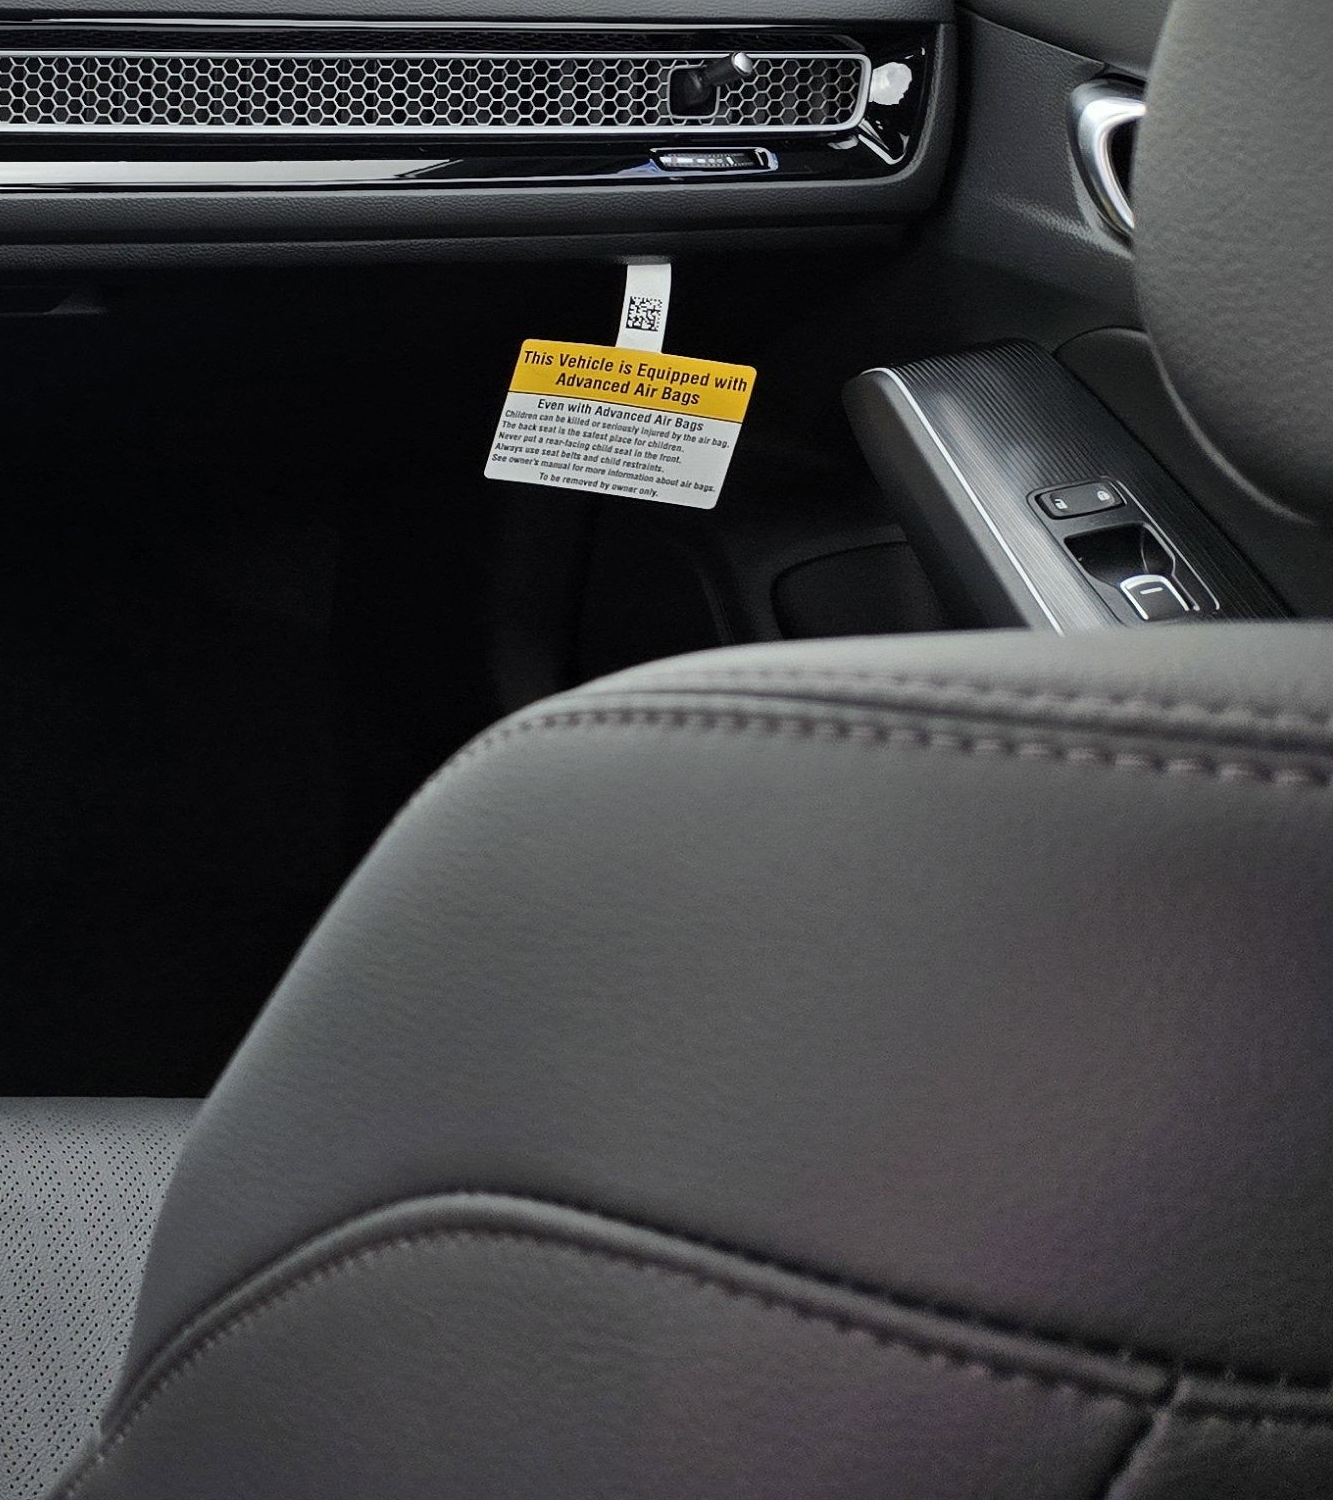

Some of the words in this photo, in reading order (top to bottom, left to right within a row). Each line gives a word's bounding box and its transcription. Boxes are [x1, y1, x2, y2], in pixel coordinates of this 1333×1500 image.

[524, 350, 554, 365] This
[559, 354, 614, 372] Vehicle
[619, 360, 633, 375] is
[637, 363, 710, 386] Equipped
[714, 376, 748, 392] with
[555, 372, 631, 394] Advanced
[633, 382, 658, 398] Air
[661, 386, 700, 406] Bags
[505, 409, 538, 420] Children
[567, 415, 590, 427] killed
[601, 422, 640, 435] seriously
[640, 426, 670, 438] injured
[683, 433, 697, 443] the
[698, 435, 711, 445] air
[712, 437, 730, 449] bag.
[537, 399, 564, 411] Even
[567, 402, 592, 414] with
[594, 405, 652, 423] Advanced
[653, 415, 672, 426] Air
[674, 417, 704, 432] Bags
[498, 431, 522, 441] Never
[545, 437, 590, 451] rear-facing
[591, 443, 613, 453] child
[614, 447, 633, 456] seat
[643, 450, 658, 460] the
[659, 452, 682, 464] front.
[501, 420, 516, 430] The
[518, 422, 537, 431] back
[538, 425, 557, 434] seat
[567, 427, 581, 437] the
[582, 429, 609, 440] safest
[609, 434, 632, 445] place
[633, 437, 647, 447] for
[647, 440, 685, 452] children.
[491, 453, 507, 462] See
[508, 456, 539, 466] owner's
[540, 460, 571, 470] manual
[585, 466, 606, 475] more
[607, 467, 654, 483] information
[655, 476, 679, 487] about
[693, 481, 716, 492] bags.
[494, 442, 523, 454] Always
[541, 448, 560, 457] seat
[560, 450, 581, 460] belts
[582, 453, 599, 463] and
[600, 455, 622, 466] child
[622, 460, 665, 473] restraints.
[562, 476, 598, 487] removed
[611, 484, 637, 494] owner
[639, 486, 659, 498] only.
